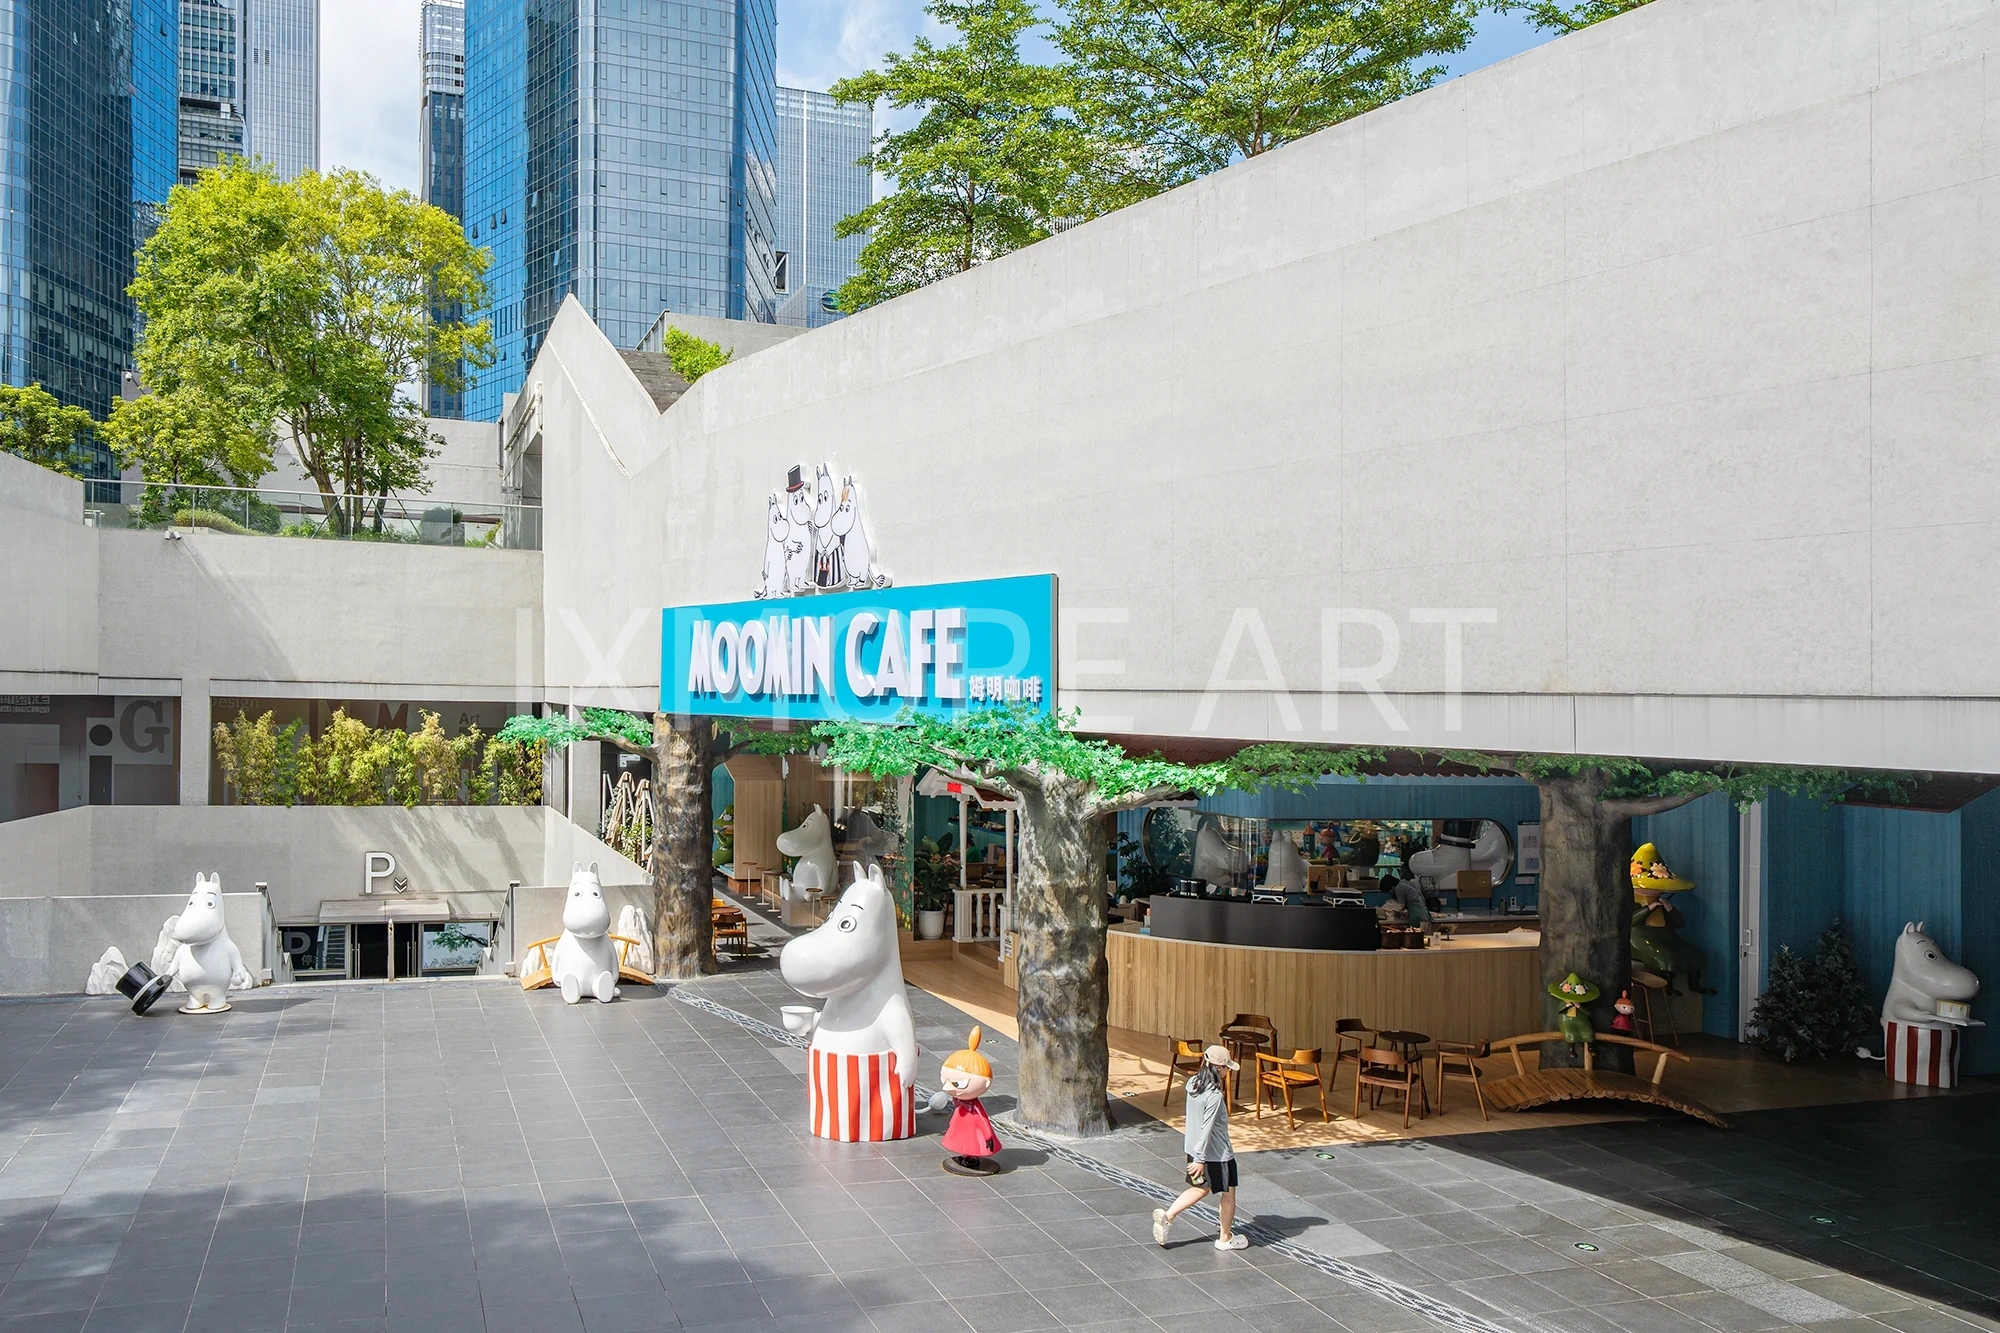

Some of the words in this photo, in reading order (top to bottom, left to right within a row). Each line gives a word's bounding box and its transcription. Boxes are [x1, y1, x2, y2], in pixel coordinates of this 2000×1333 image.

[688, 614, 835, 698] MOOMIN
[846, 607, 967, 699] CAFE
[968, 675, 1043, 702] 姆明咖啡
[458, 712, 481, 725] Art
[363, 851, 397, 894] P
